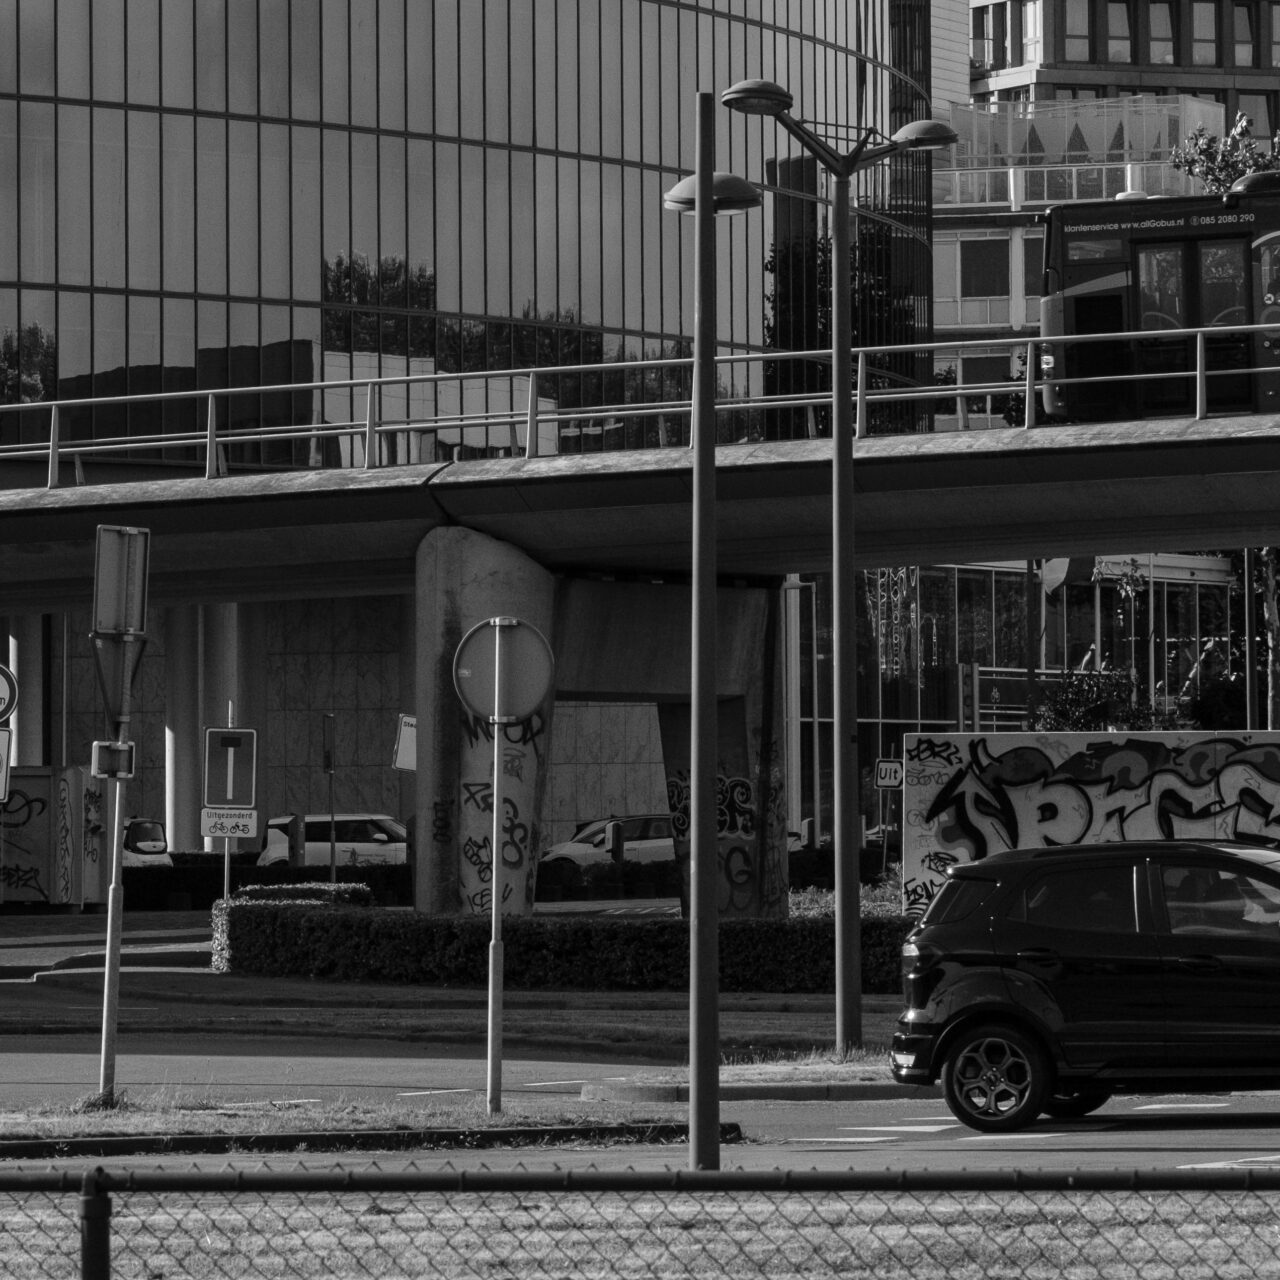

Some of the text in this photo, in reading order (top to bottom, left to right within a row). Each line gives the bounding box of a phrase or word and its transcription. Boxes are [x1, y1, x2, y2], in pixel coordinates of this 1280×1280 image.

[1064, 212, 1255, 233] klantenservice www.allGobus.nl 085 2080 290
[879, 767, 898, 781] Uit
[206, 811, 253, 821] Uitgezonderd
